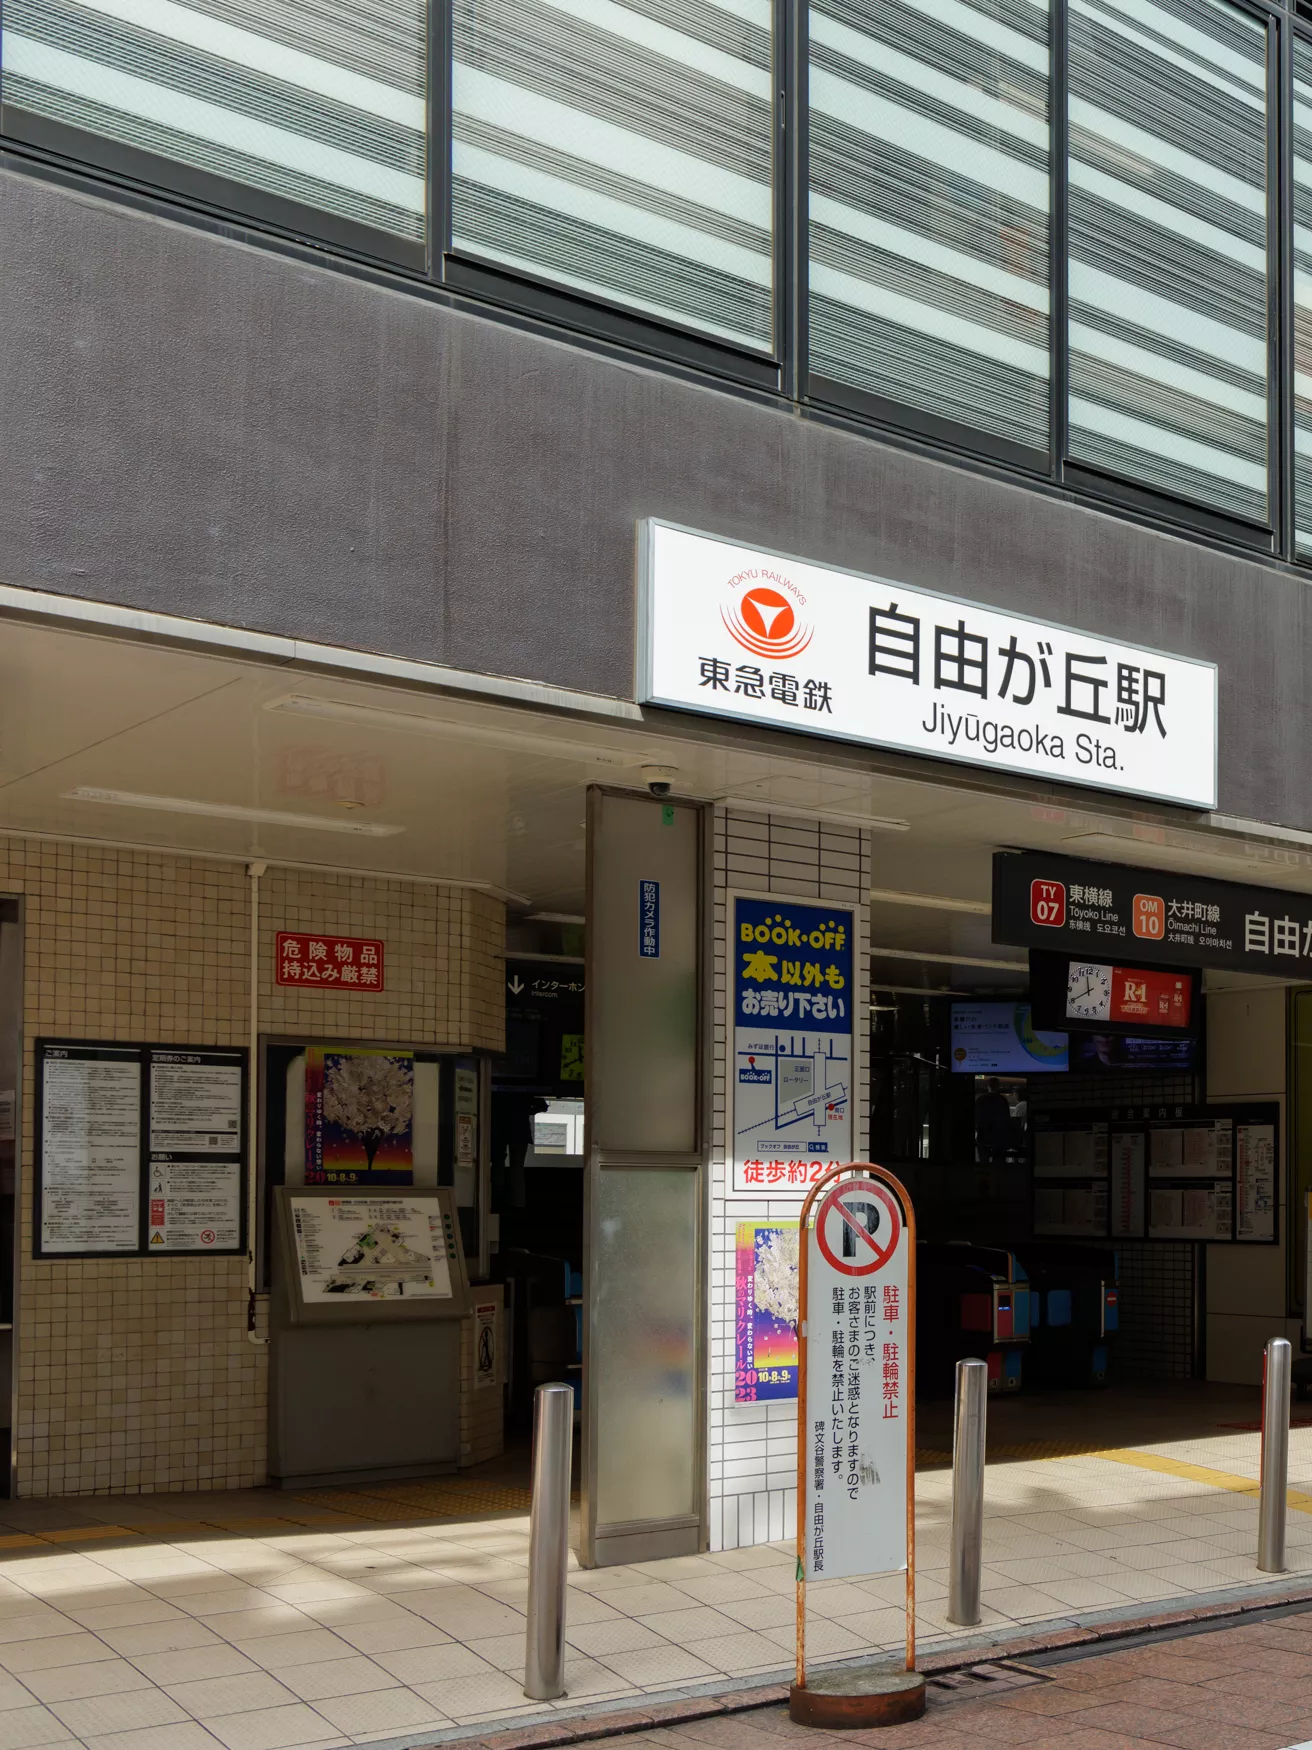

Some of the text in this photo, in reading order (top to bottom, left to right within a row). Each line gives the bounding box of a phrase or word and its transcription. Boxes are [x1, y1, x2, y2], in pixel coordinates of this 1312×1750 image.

[727, 568, 807, 606] TOKYU RAILWAYS
[867, 601, 1168, 740] 自由が丘駅
[698, 656, 834, 714] 東急電鉄
[922, 702, 1126, 772] Jiyūgaoka Sta.
[1040, 884, 1057, 899] TY
[1069, 884, 1113, 908] 東横線
[1036, 902, 1059, 921] 07
[1069, 905, 1119, 923] Tōyoko Line
[1139, 899, 1158, 913] OM
[1168, 899, 1220, 922] 大井町線
[643, 882, 656, 956] 防犯カメラ作動中
[1069, 919, 1126, 936] 东横线 도요코선
[1139, 915, 1159, 935] 10
[1201, 923, 1217, 936] Line
[282, 939, 378, 964] 危険物品
[1198, 935, 1233, 950] 오이마치선
[282, 961, 379, 985] 持込み厳禁
[742, 950, 845, 989] 本以外も
[531, 979, 585, 992] インターホン
[531, 990, 558, 998] Intercom
[742, 988, 845, 1020] お売り下さい
[747, 1043, 775, 1051] みずほ銀行
[736, 1276, 747, 1370] 秋のマリクレール
[863, 1285, 877, 1363] 駅前につき、
[882, 1285, 900, 1420] 駐車・駐輪禁止
[735, 1370, 758, 1386] 20
[831, 1286, 846, 1481] 駐車・駐輪を禁止いたします。
[735, 1387, 757, 1402] 23
[846, 1286, 862, 1500] お客さまのご迷惑となりますので
[812, 1420, 826, 1572] 碑文谷警察署・自由が丘駅長
